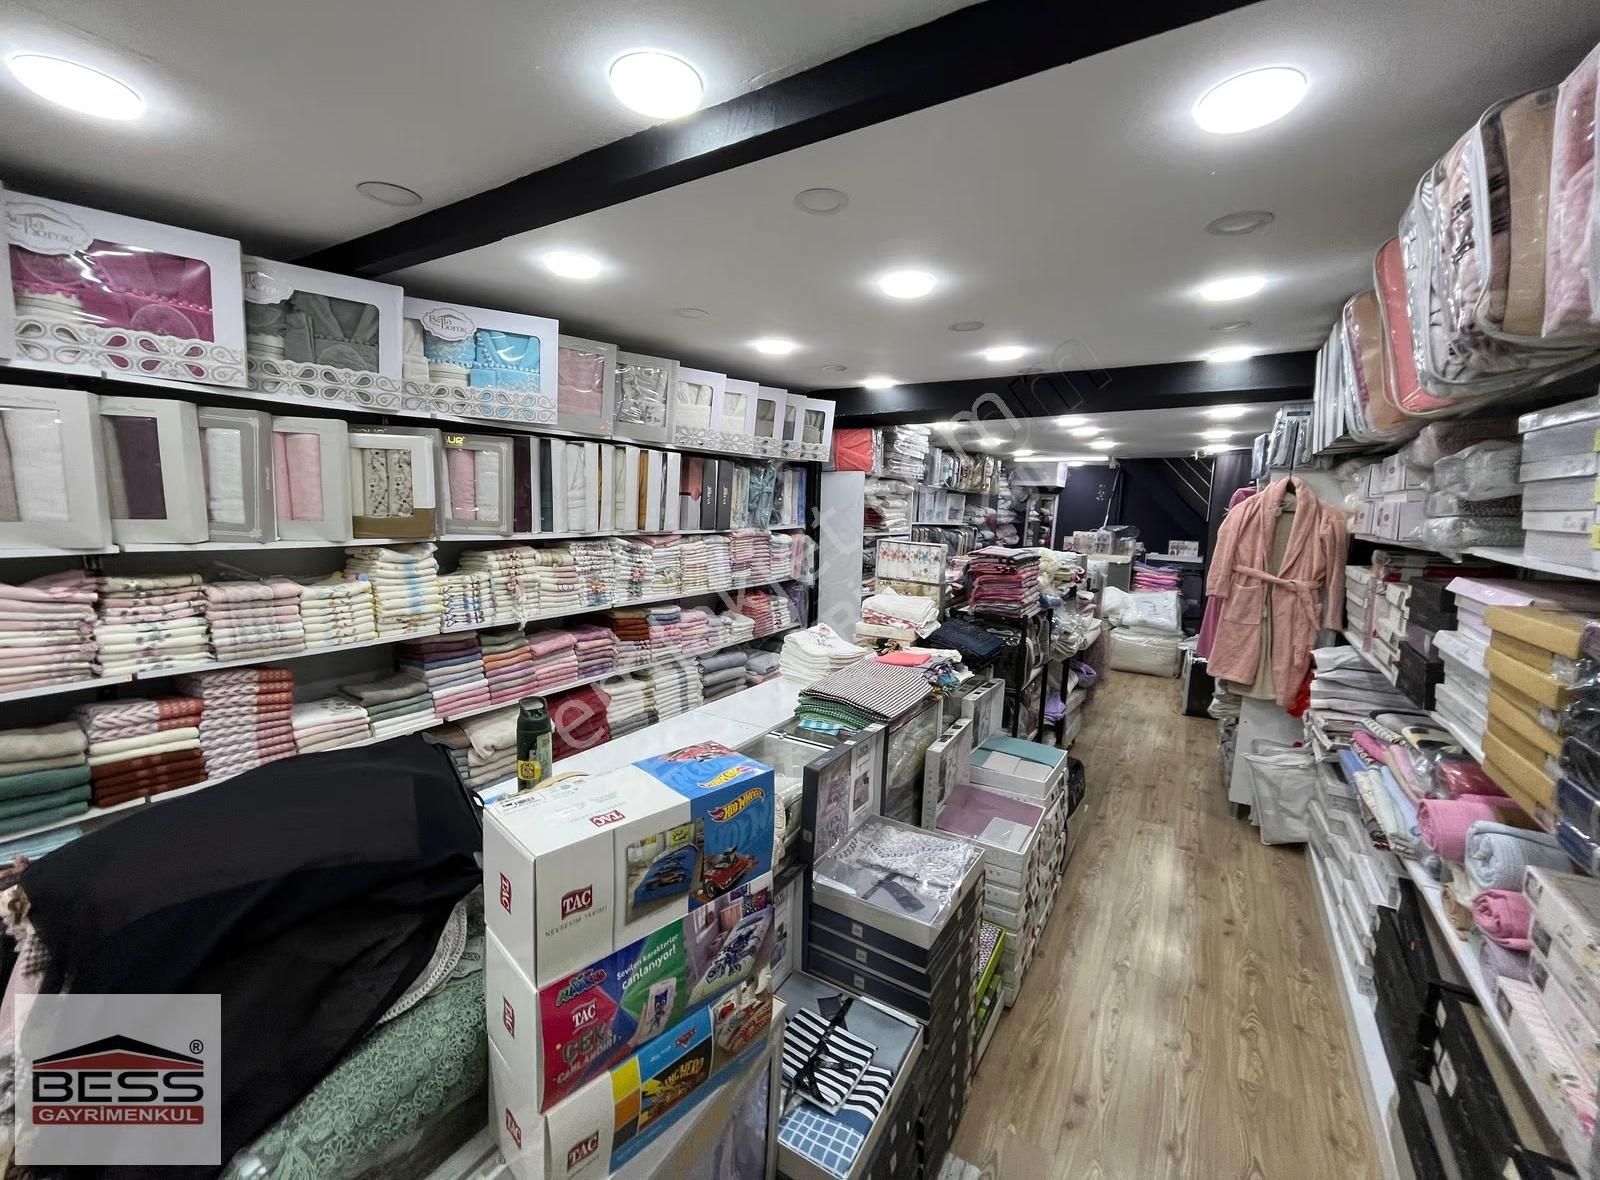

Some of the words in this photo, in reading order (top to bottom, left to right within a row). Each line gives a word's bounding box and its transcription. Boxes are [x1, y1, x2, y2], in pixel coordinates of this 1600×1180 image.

[562, 889, 592, 914] TAC
[572, 1003, 597, 1028] TAC
[568, 1133, 598, 1164] TAC
